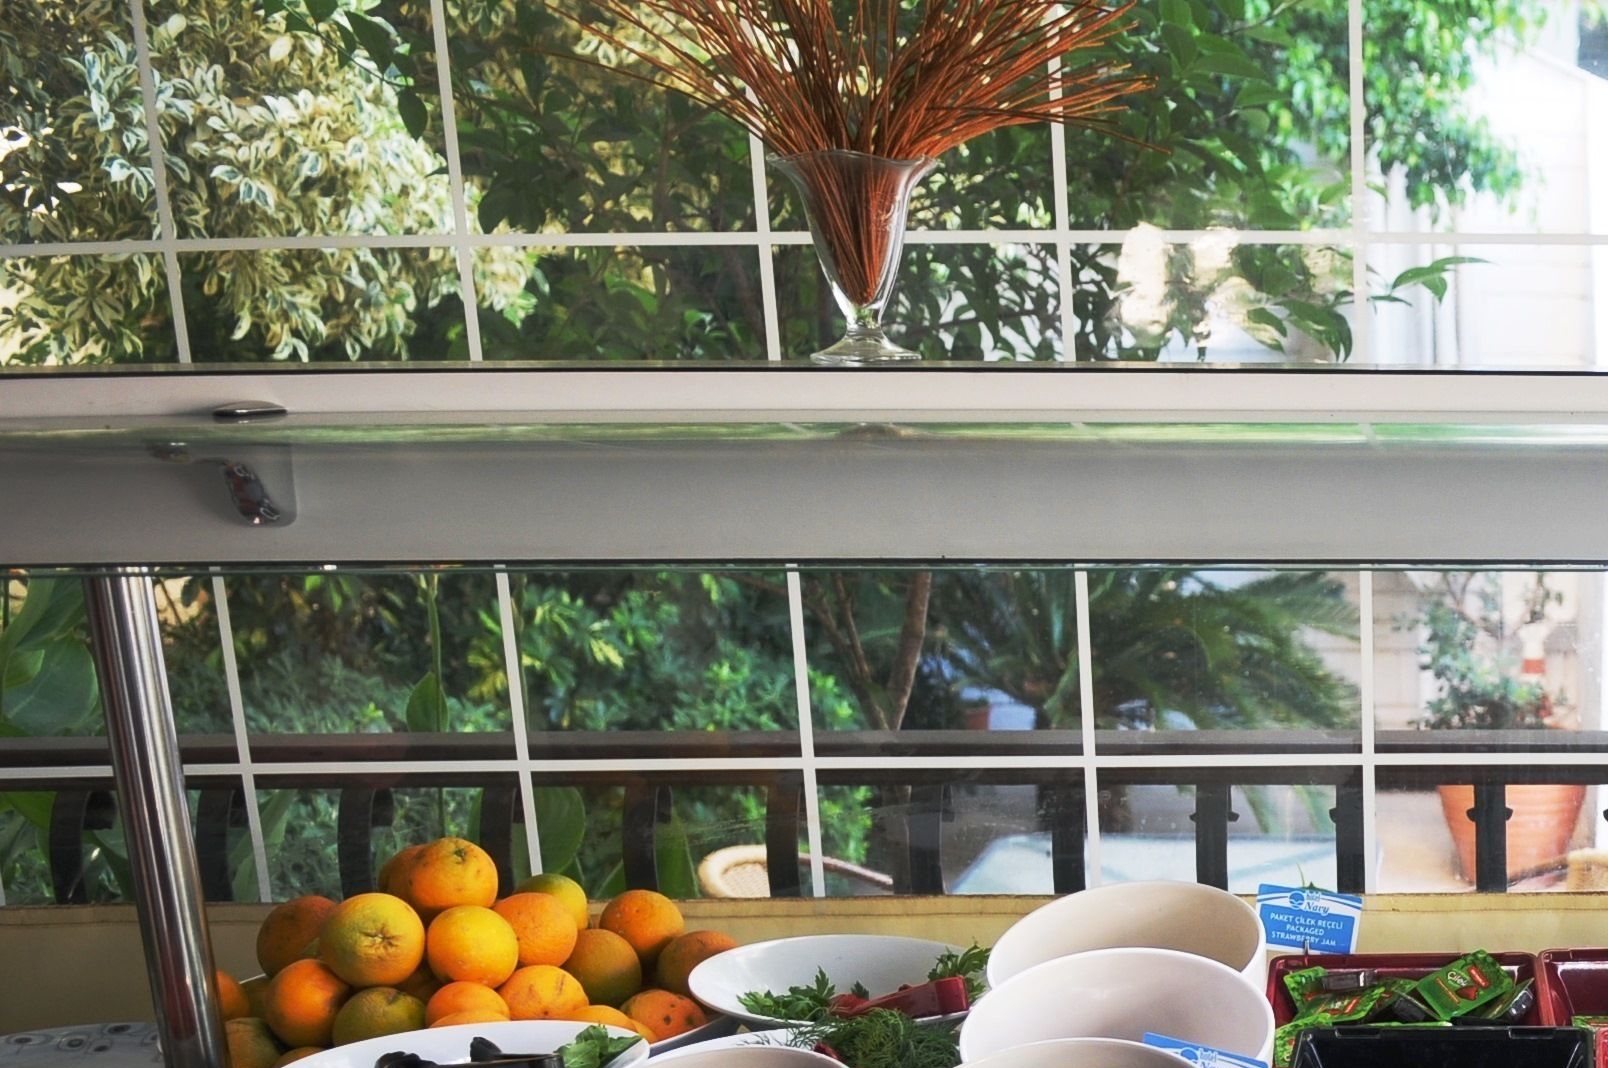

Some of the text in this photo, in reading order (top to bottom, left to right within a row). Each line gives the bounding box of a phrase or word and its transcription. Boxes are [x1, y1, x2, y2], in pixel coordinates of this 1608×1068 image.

[1304, 901, 1330, 916] Navy
[1270, 912, 1294, 923] PAKET
[1286, 924, 1325, 936] PACKAGED
[1320, 939, 1337, 947] JAM
